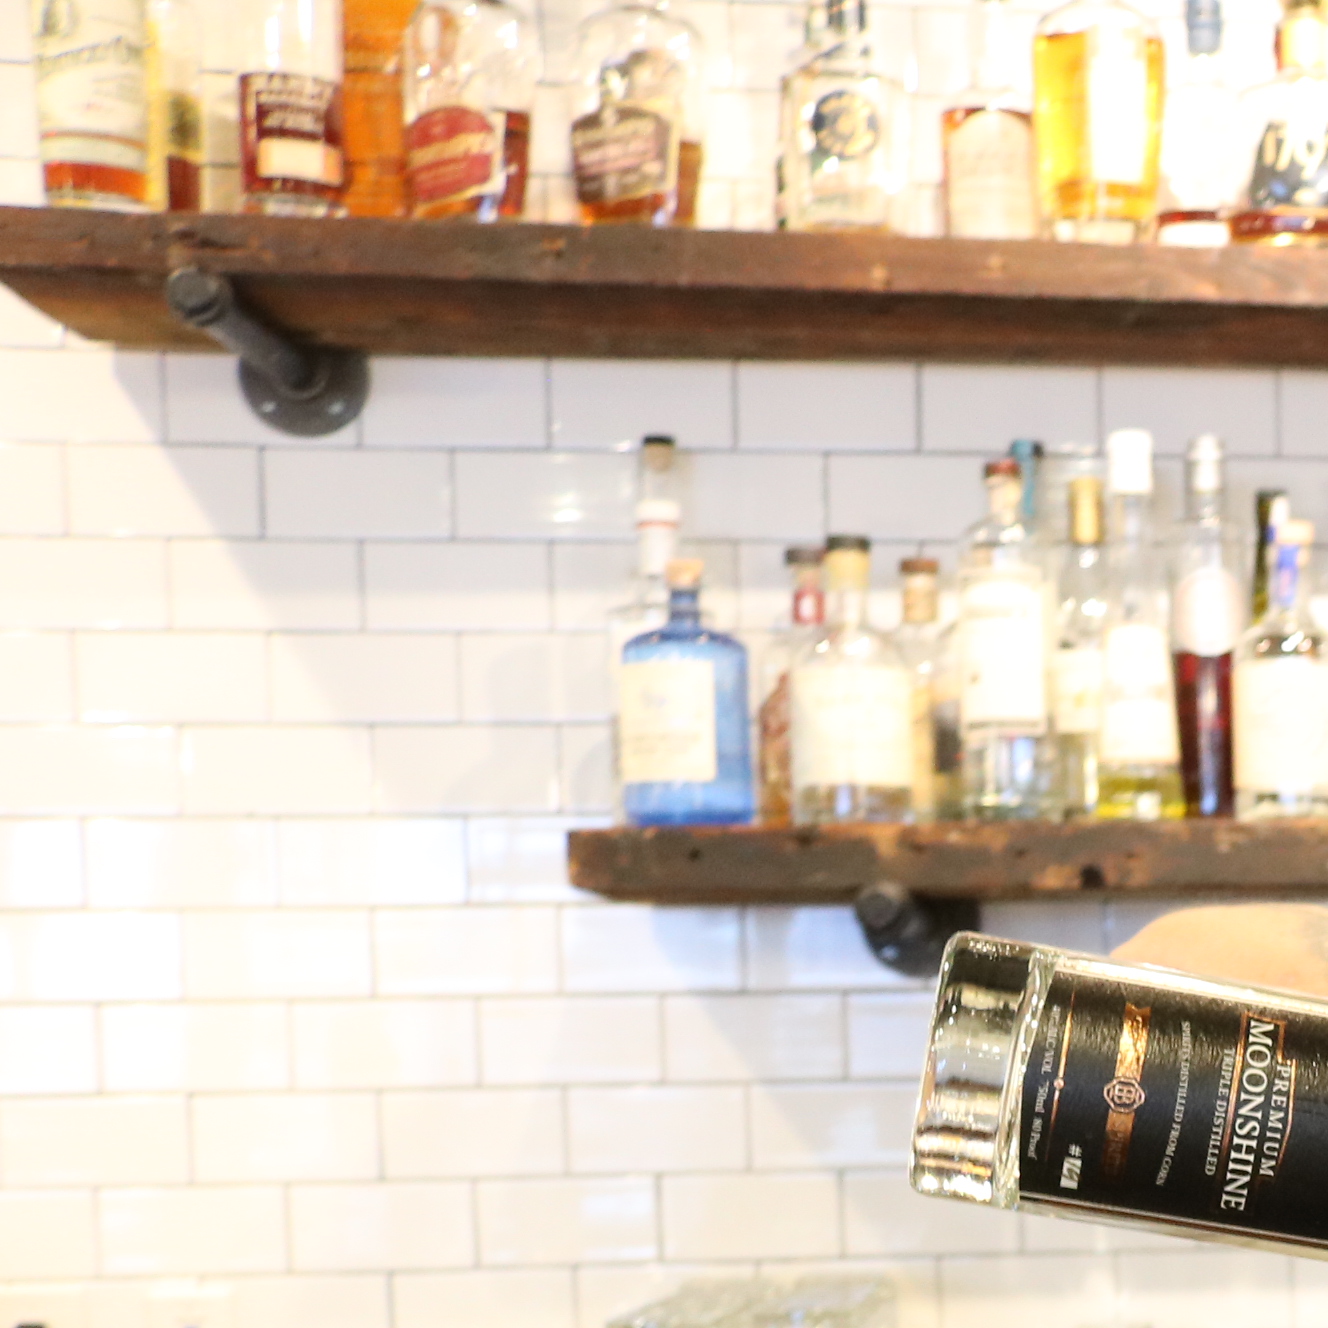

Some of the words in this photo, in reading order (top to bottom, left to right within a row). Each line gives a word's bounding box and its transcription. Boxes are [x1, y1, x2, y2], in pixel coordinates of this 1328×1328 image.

[1180, 1021, 1190, 1061] SPIRITS
[1174, 1061, 1190, 1121] DISTILLED
[1218, 1048, 1235, 1096] TRIPLE
[1165, 1122, 1180, 1157] FROM
[1204, 1100, 1228, 1176] DISTILLED
[1220, 1020, 1274, 1211] MOONSHINE
[1259, 1065, 1291, 1176] PREMIUM
[1027, 1132, 1040, 1160] Proof
[1155, 1157, 1172, 1186] CORN
